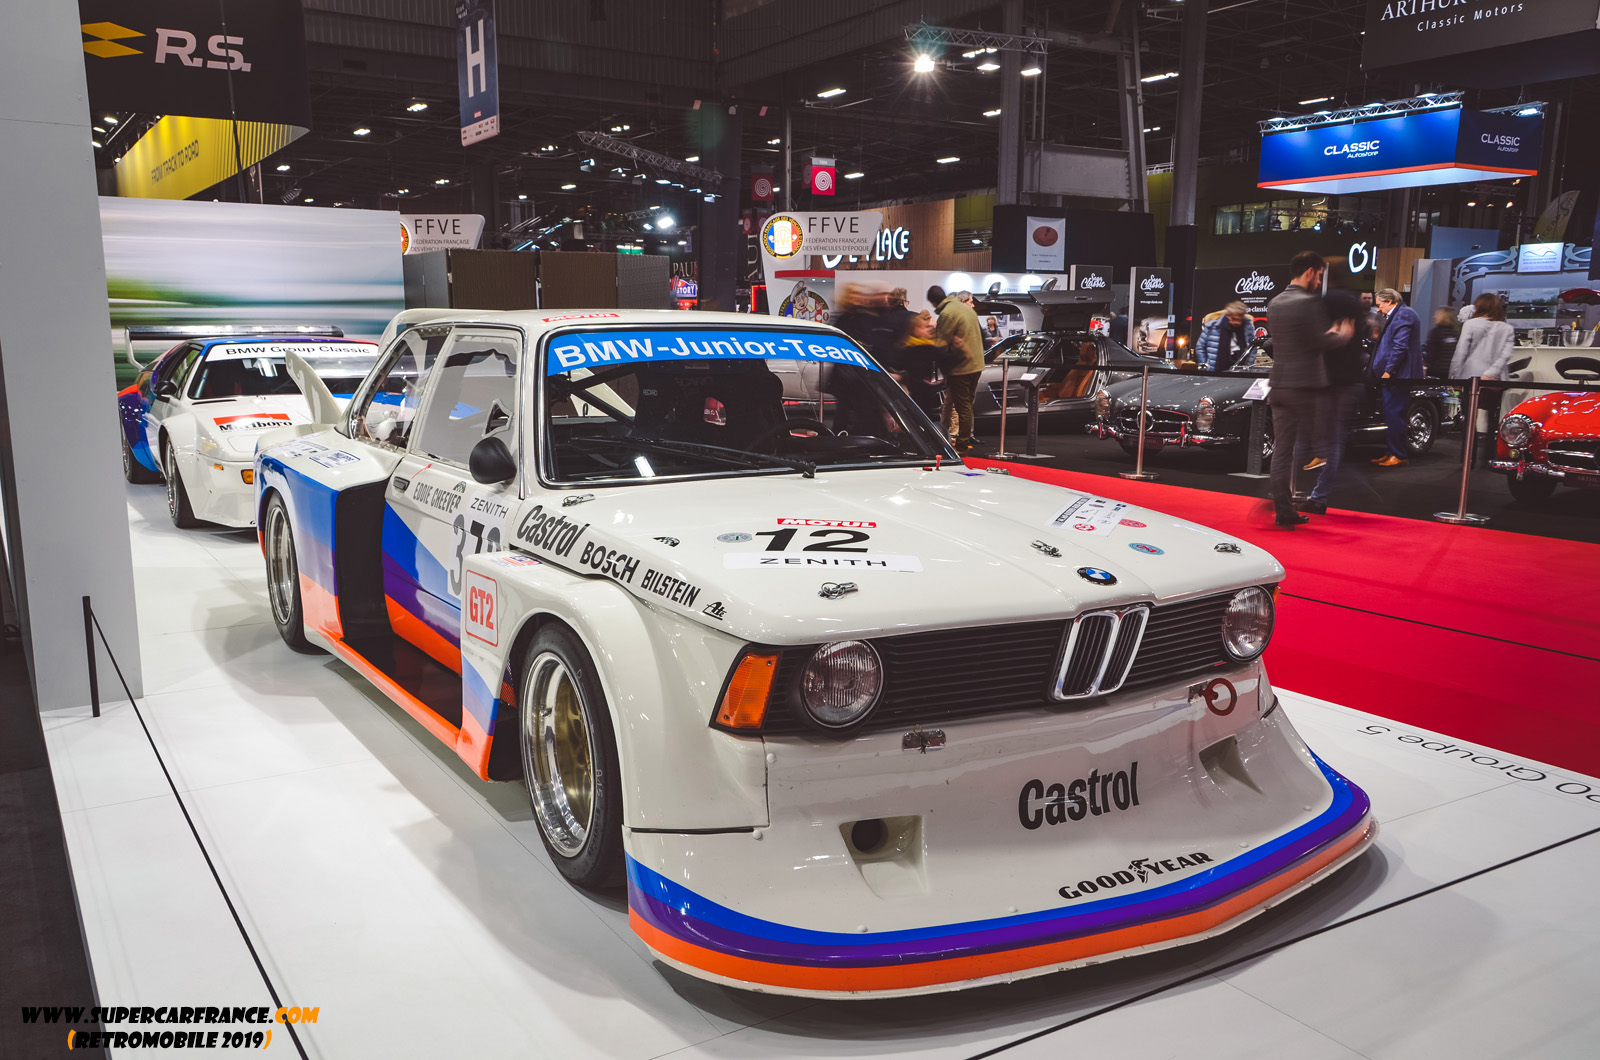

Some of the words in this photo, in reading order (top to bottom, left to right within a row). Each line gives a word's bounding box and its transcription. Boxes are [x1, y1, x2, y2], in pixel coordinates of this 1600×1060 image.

[1417, 14, 1465, 32] Classic
[1473, 3, 1523, 21] Motors
[155, 28, 252, 72] R.S.
[465, 19, 486, 98] H
[1324, 140, 1380, 156] CLASSIC
[1481, 133, 1520, 147] CLASSIC
[151, 167, 164, 185] FROM
[162, 153, 178, 178] TRACK
[176, 149, 185, 168] TO
[184, 139, 200, 164] ROAD
[414, 219, 462, 235] FFVE
[808, 216, 859, 233] FFVE
[838, 237, 868, 245] FRANÇAISE
[842, 244, 870, 252] D'ÉPOQUE
[1235, 277, 1275, 295] Classic
[1251, 271, 1271, 285] Saga
[226, 346, 266, 355] BMW
[270, 345, 315, 354] Group
[318, 344, 371, 354] Classic
[553, 336, 871, 370] BMW-Junior-Team
[412, 481, 434, 505] EDDIE
[430, 487, 462, 514] CHEEVER
[470, 497, 509, 519] ZENITH
[781, 519, 875, 528] MOTUL
[755, 528, 870, 553] 12
[516, 505, 591, 557] Castrol
[579, 540, 641, 584] BOSCH
[641, 568, 702, 608] BILSTEIN
[760, 557, 888, 567] ZENITH
[469, 585, 495, 630] GT2
[1357, 725, 1391, 736] 5
[1397, 734, 1547, 782] Groupe
[1018, 761, 1140, 830] Castrol
